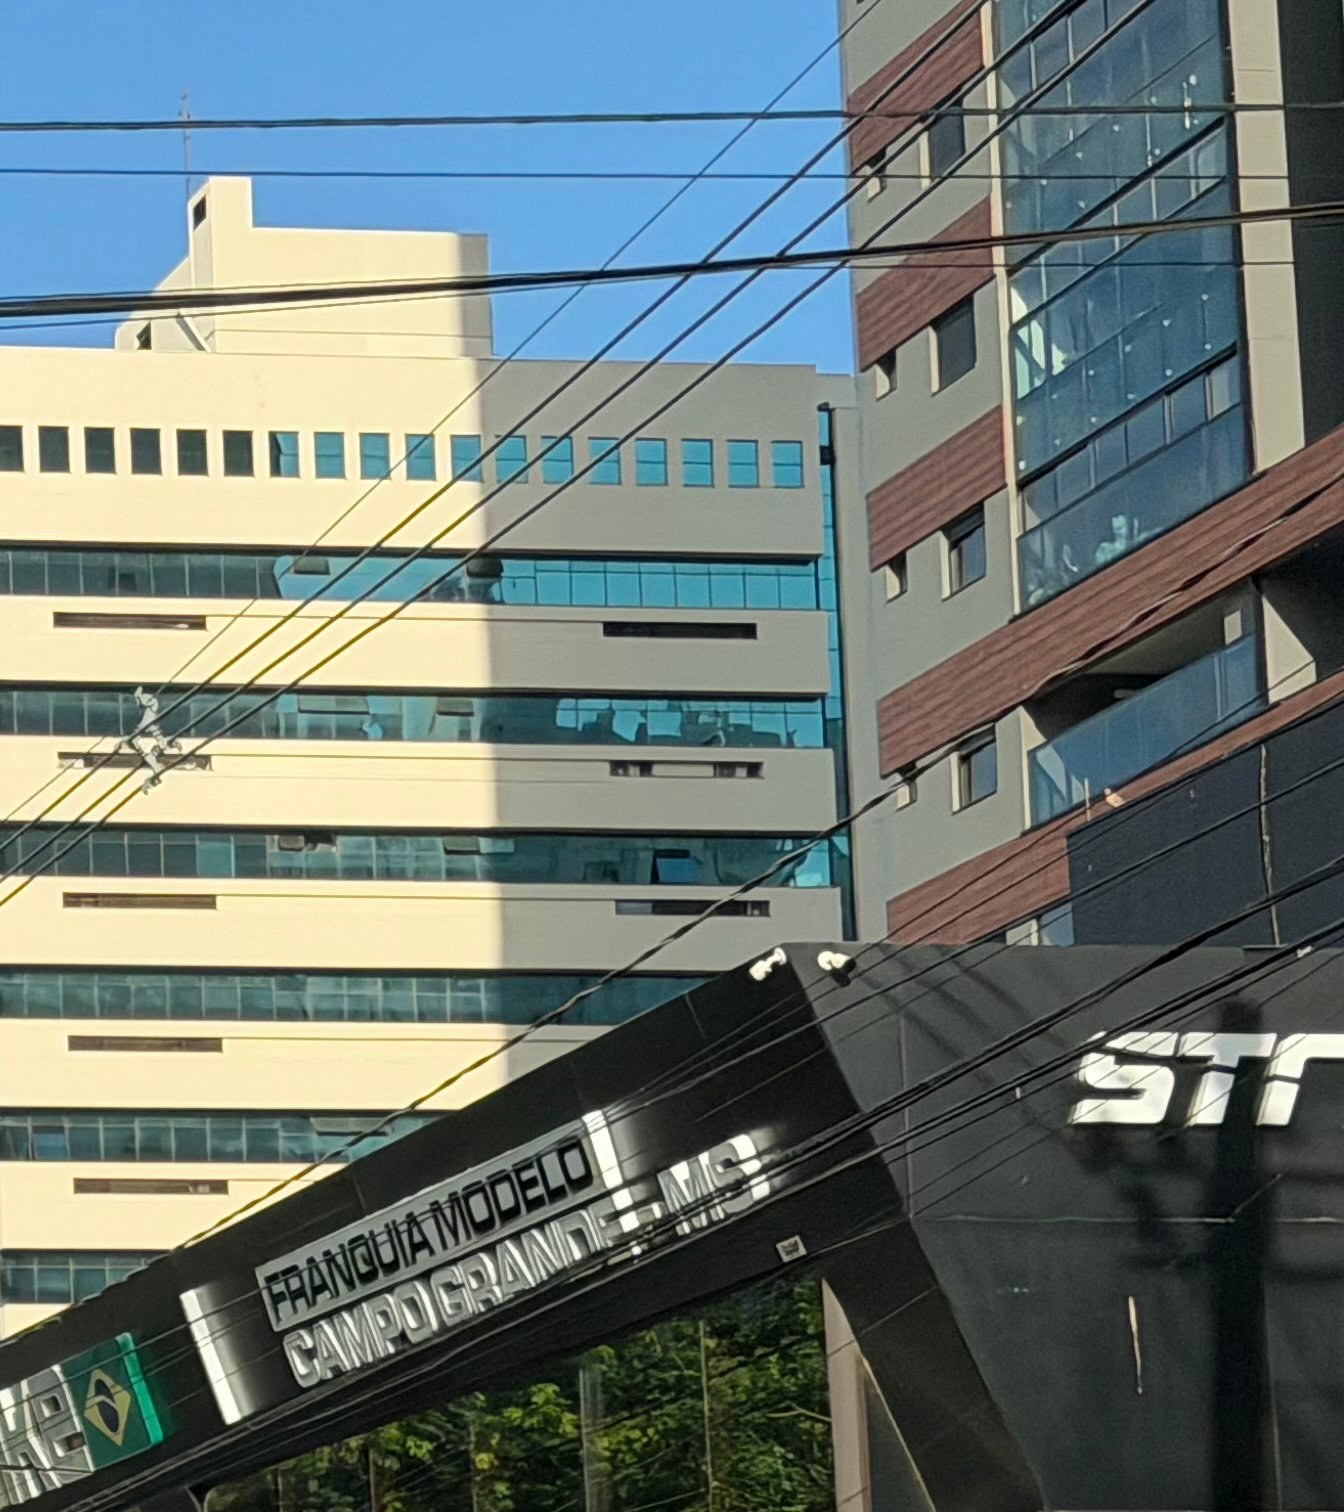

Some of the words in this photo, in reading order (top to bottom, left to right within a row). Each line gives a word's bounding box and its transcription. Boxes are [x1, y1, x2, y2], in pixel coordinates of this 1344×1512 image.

[264, 1211, 438, 1323] FRANQUIA
[430, 1136, 594, 1251] MODELO
[283, 1281, 438, 1389] CAMPO
